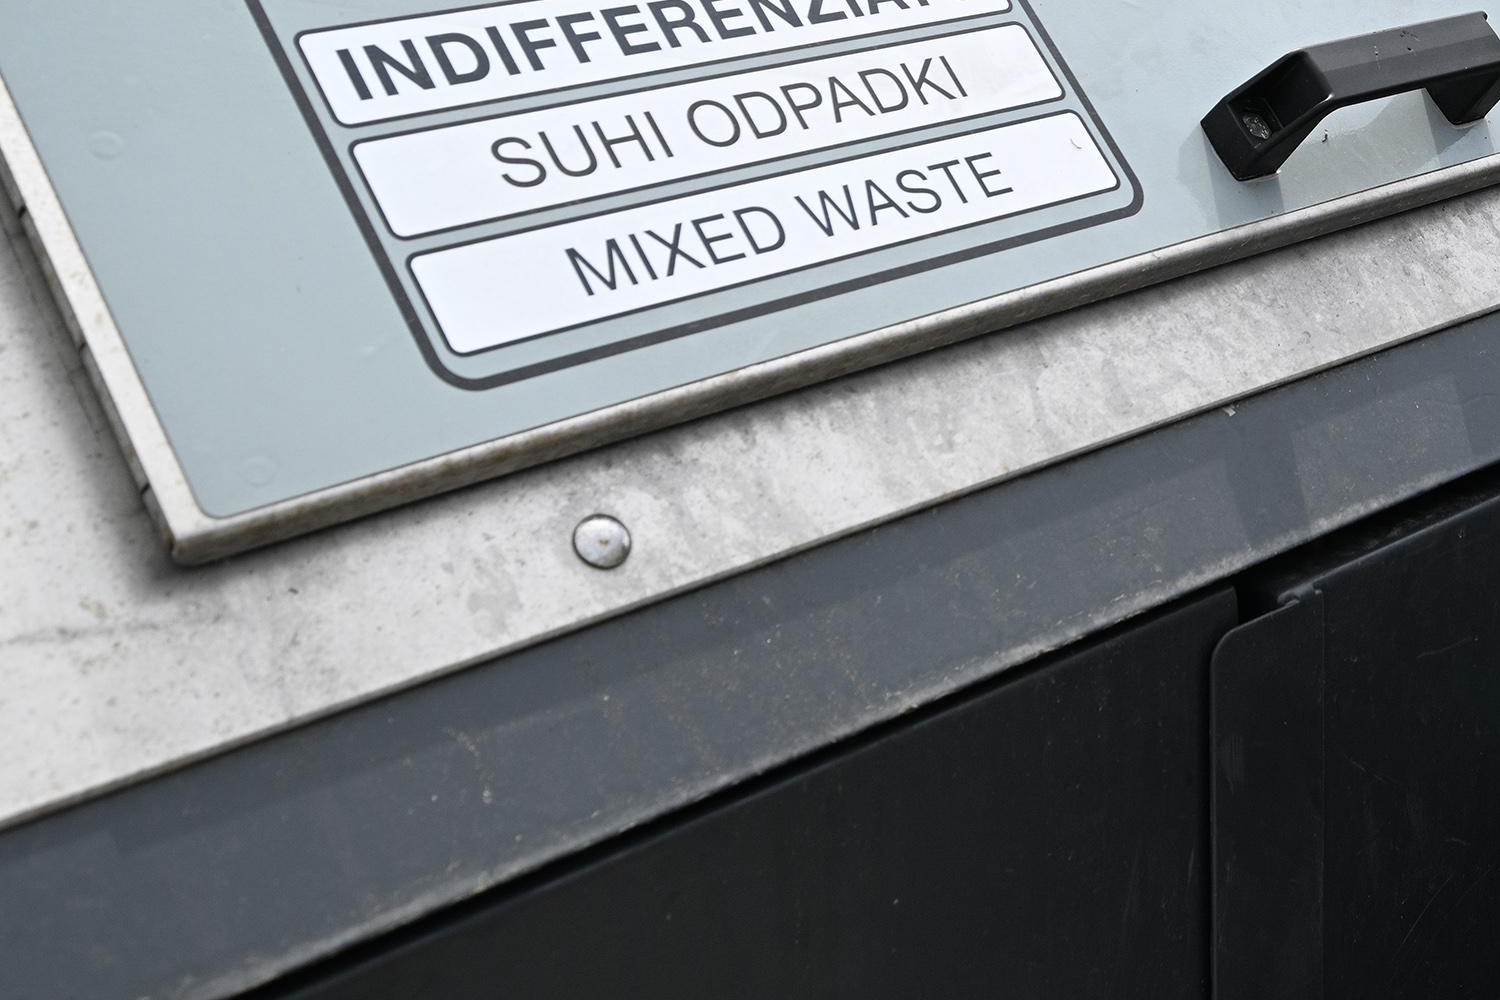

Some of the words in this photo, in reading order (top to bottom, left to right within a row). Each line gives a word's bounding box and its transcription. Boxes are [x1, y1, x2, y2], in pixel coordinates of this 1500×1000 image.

[492, 112, 675, 187] SUHI
[688, 56, 967, 147] ODPADKI
[566, 207, 785, 295] MIXED
[795, 153, 1013, 236] WASTE
